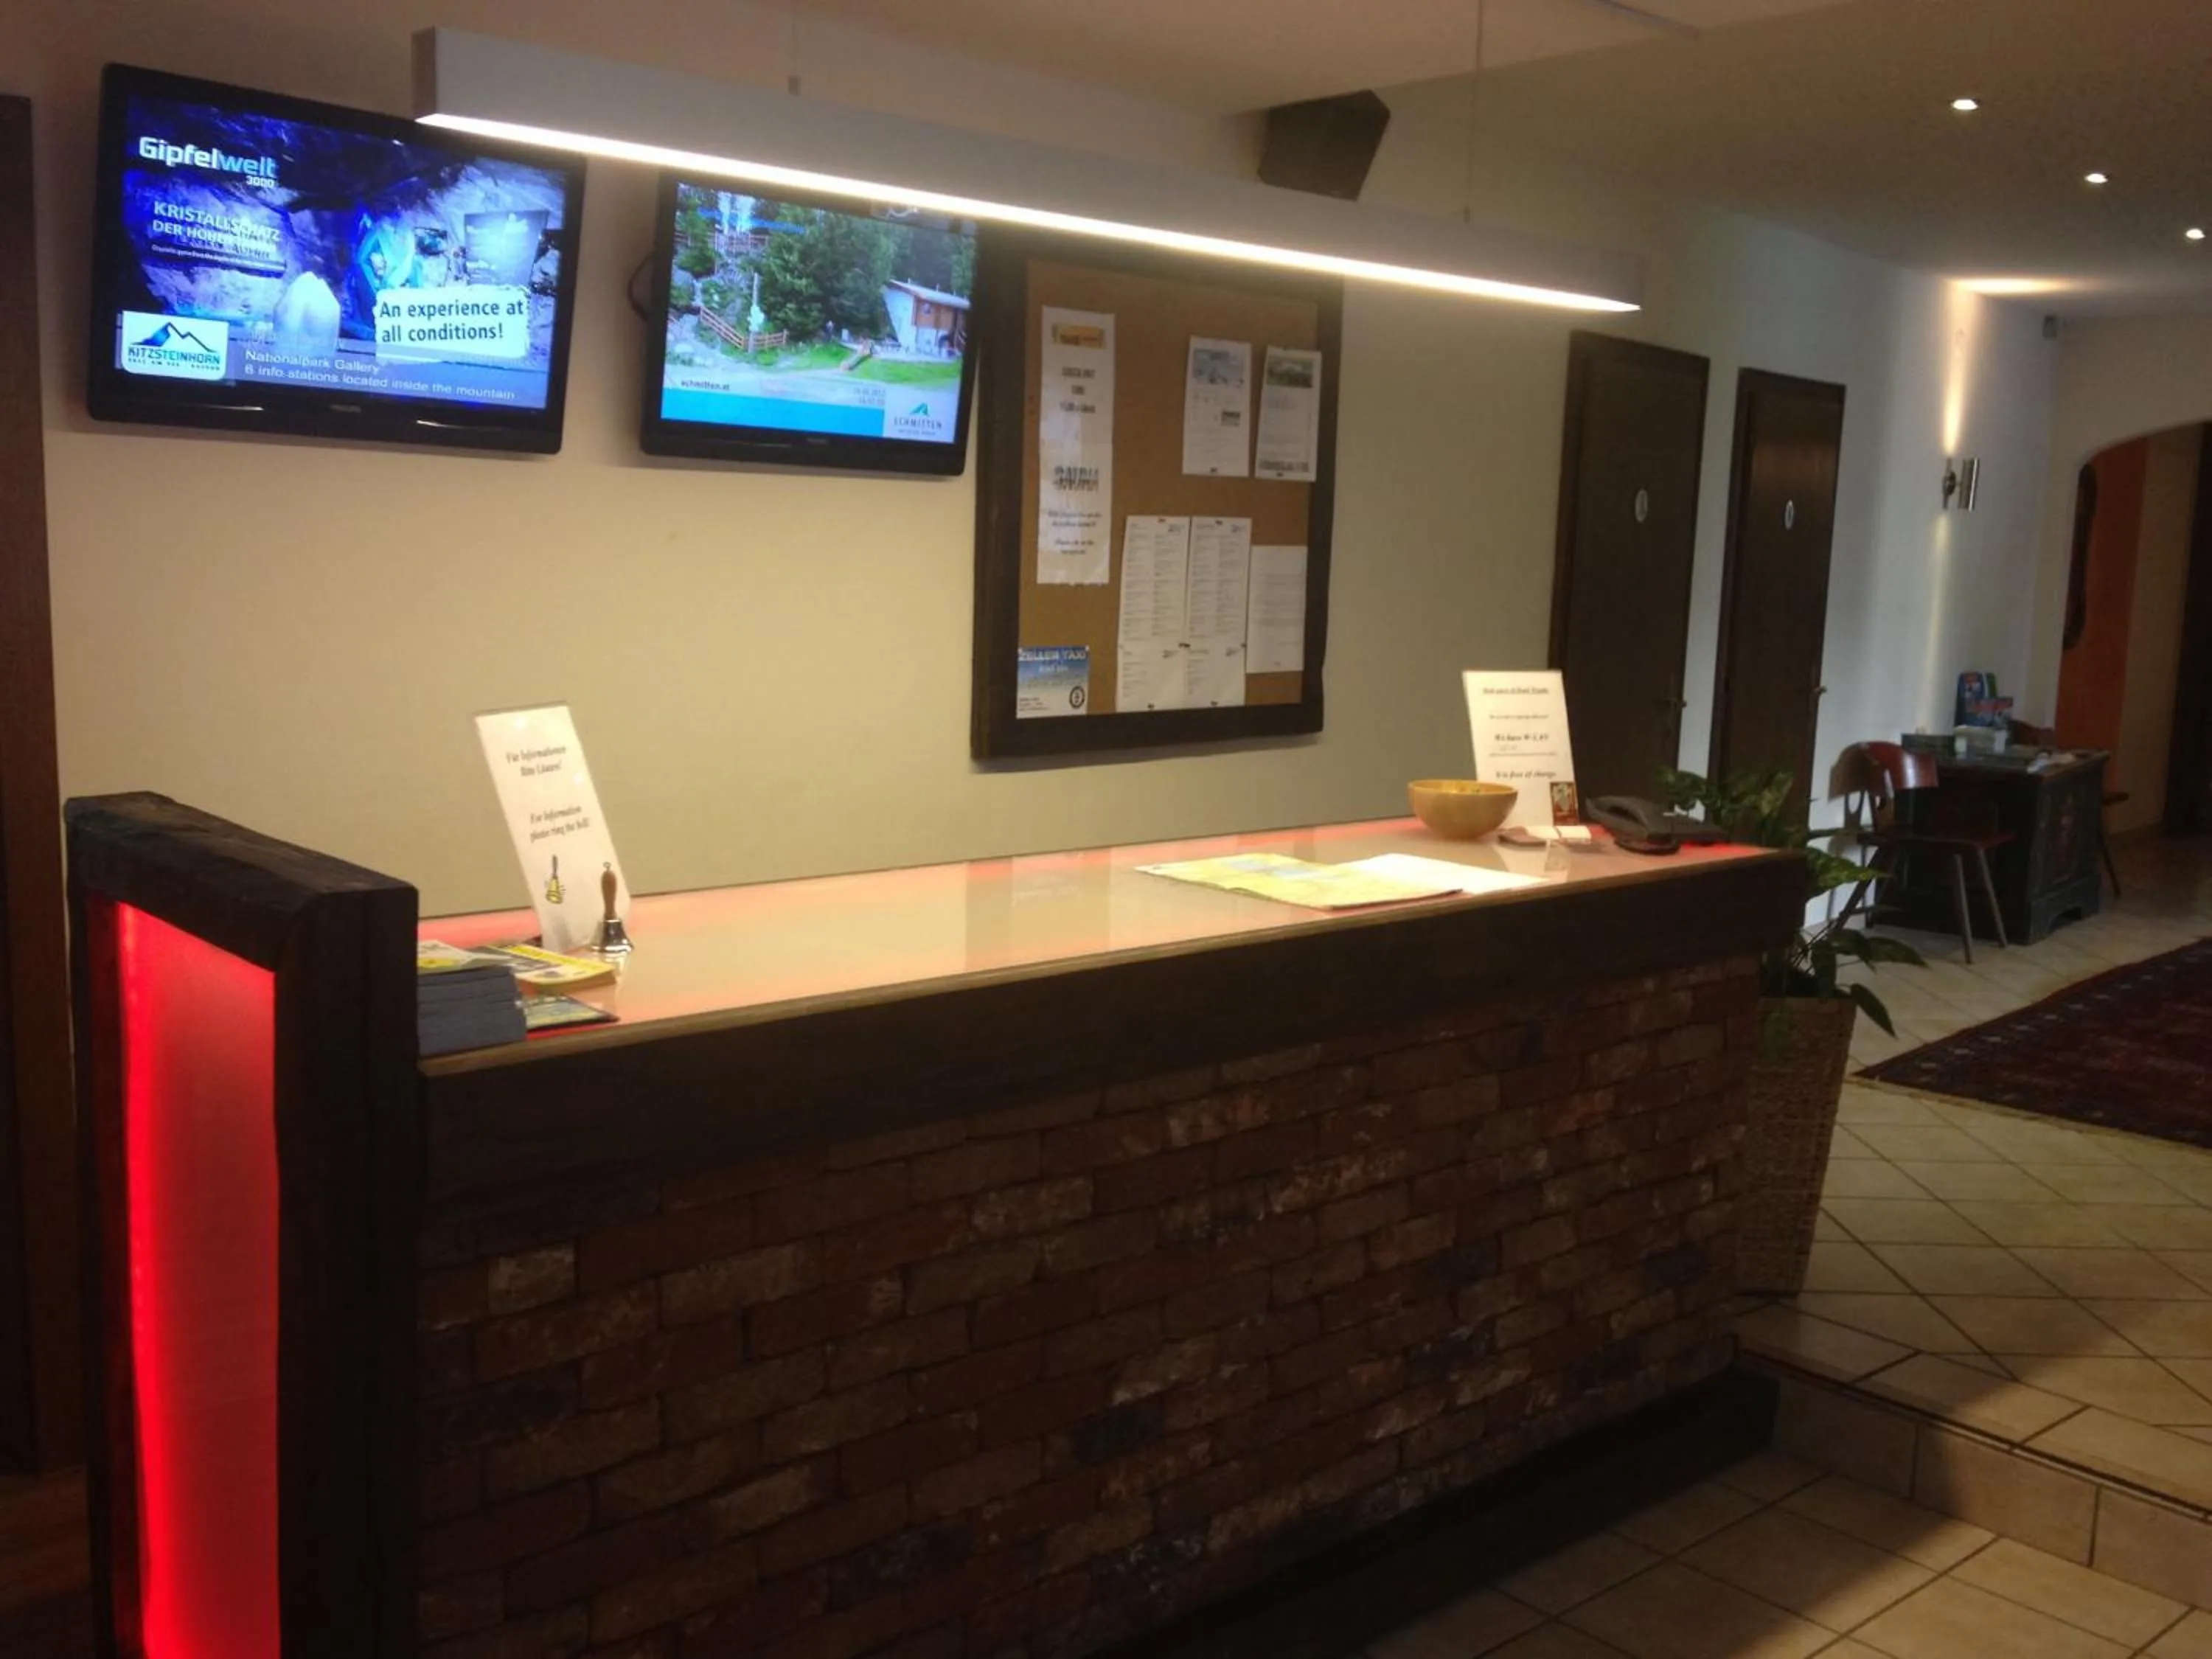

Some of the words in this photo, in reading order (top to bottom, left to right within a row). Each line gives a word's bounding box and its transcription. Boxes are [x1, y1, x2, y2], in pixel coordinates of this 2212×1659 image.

[139, 136, 278, 178] Gipfelwelt
[246, 175, 276, 187] 3000
[153, 220, 182, 236] DER
[380, 301, 401, 318] An
[408, 299, 500, 321] experience
[507, 300, 524, 316] at
[382, 324, 402, 342] all
[408, 323, 504, 341] conditions!
[128, 347, 220, 364] KITZSTEINHORN
[245, 350, 330, 368] Nationalpark
[335, 359, 380, 375] Gallery
[343, 374, 388, 388] located
[392, 378, 428, 392] inside
[432, 382, 452, 394] the
